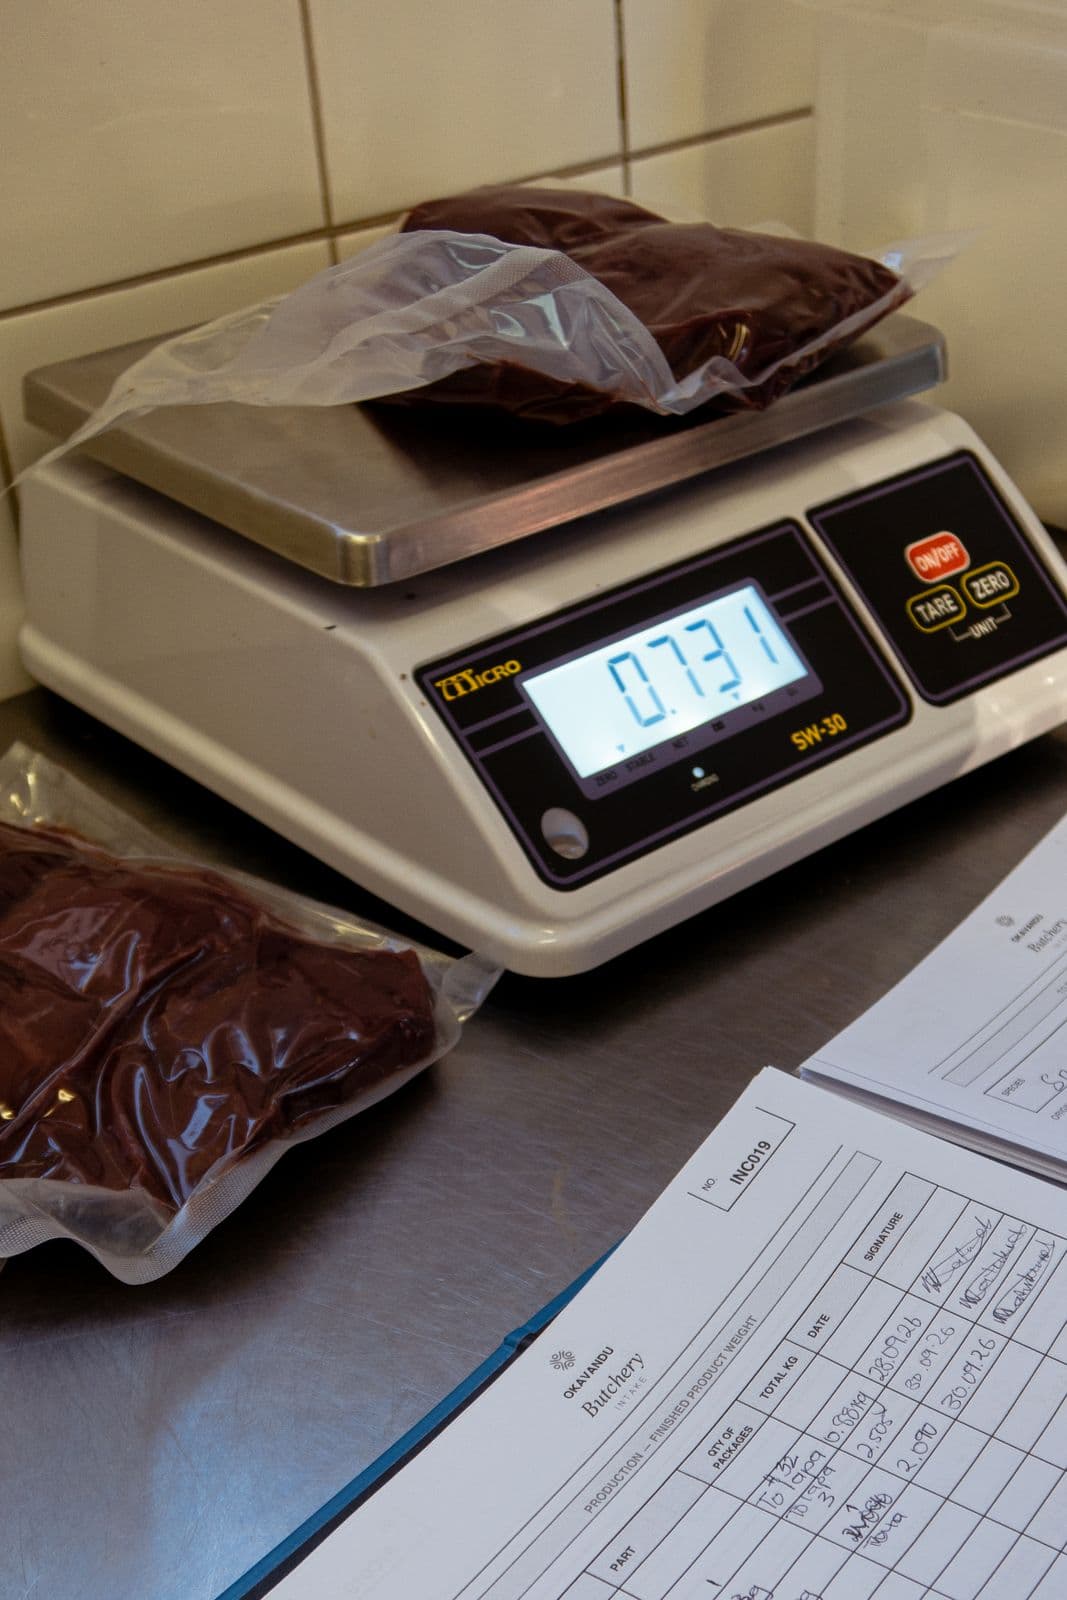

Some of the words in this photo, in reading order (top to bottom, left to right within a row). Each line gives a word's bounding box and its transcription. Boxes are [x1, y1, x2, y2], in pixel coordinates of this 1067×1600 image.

[914, 542, 960, 572] ON/OFF
[970, 571, 1010, 599] ZERO
[914, 593, 959, 622] TARE
[968, 616, 998, 638] UNIT
[607, 606, 779, 727] 0.731
[790, 713, 848, 751] SW-30
[729, 1140, 771, 1186] INC019
[701, 1177, 718, 1192] NO.
[863, 1211, 904, 1262] SIGNATURE
[807, 1313, 831, 1339] DATE
[563, 1346, 614, 1399] OKAVANDU
[581, 1353, 645, 1418] Butchery
[760, 1371, 786, 1400] TOTAL
[782, 1355, 798, 1372] KG
[615, 1376, 648, 1411] INTAKE
[584, 1452, 644, 1514] PRODUCTION
[649, 1399, 690, 1443] FINISHED
[686, 1353, 727, 1400] PRODUCT
[723, 1315, 758, 1354] WEIGHT
[707, 1440, 726, 1458] QTY
[722, 1427, 736, 1440] OF
[712, 1425, 753, 1470] PACKAGES
[609, 1546, 636, 1572] PART
